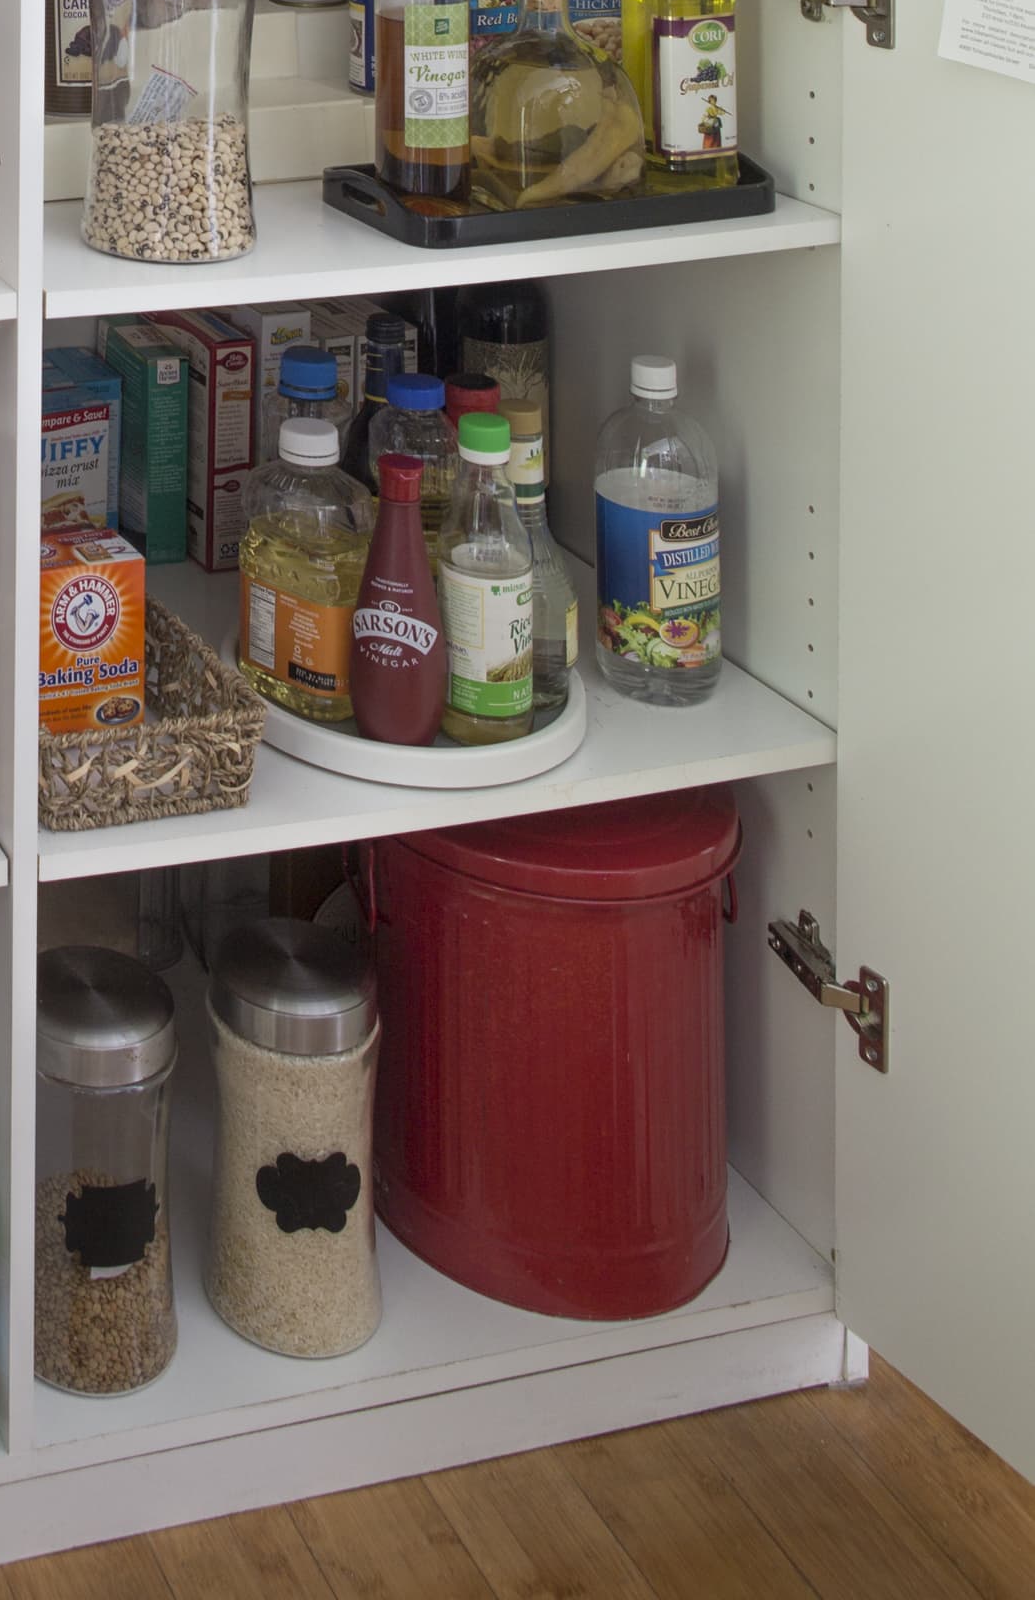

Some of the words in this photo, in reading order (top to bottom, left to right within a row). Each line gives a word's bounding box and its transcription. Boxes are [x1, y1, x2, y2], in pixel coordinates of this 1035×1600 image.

[477, 14, 505, 27] Red
[409, 50, 445, 61] WHITE
[409, 65, 465, 87] Vinegar
[73, 412, 81, 422] &
[82, 408, 107, 421] Save!
[70, 458, 99, 473] crust
[57, 475, 80, 488] mix
[668, 523, 701, 538] Best
[662, 545, 711, 567] DISTILLED
[56, 591, 70, 624] ARM
[68, 583, 80, 596] &
[79, 579, 115, 617] HAMMER
[354, 611, 434, 649] SARSON'S
[369, 642, 403, 656] Malt
[76, 656, 100, 667] Pure
[40, 670, 94, 686] Baking
[99, 659, 139, 678] Soda
